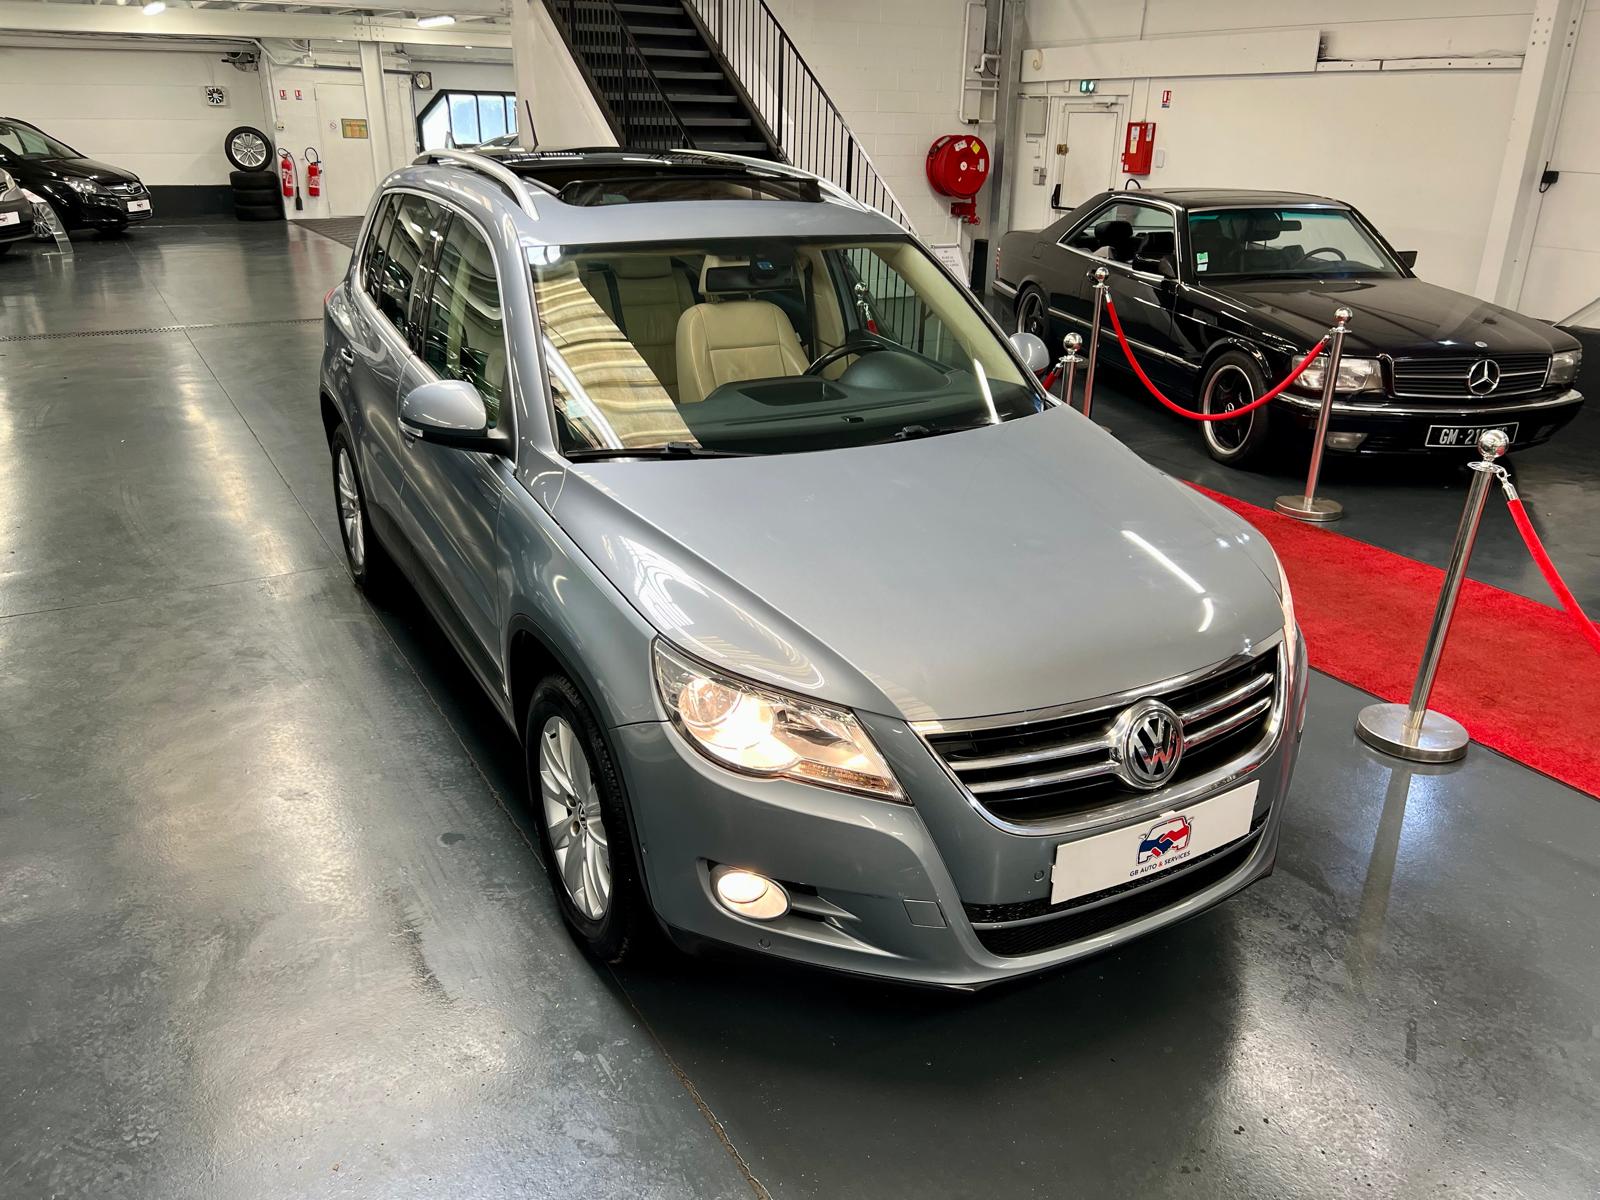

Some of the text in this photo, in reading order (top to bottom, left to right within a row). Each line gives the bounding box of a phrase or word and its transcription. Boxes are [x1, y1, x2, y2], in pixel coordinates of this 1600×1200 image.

[1129, 710, 1177, 781] VW
[1130, 869, 1139, 877] GB
[1140, 863, 1157, 873] AUTO
[1164, 850, 1191, 864] SERVICES
